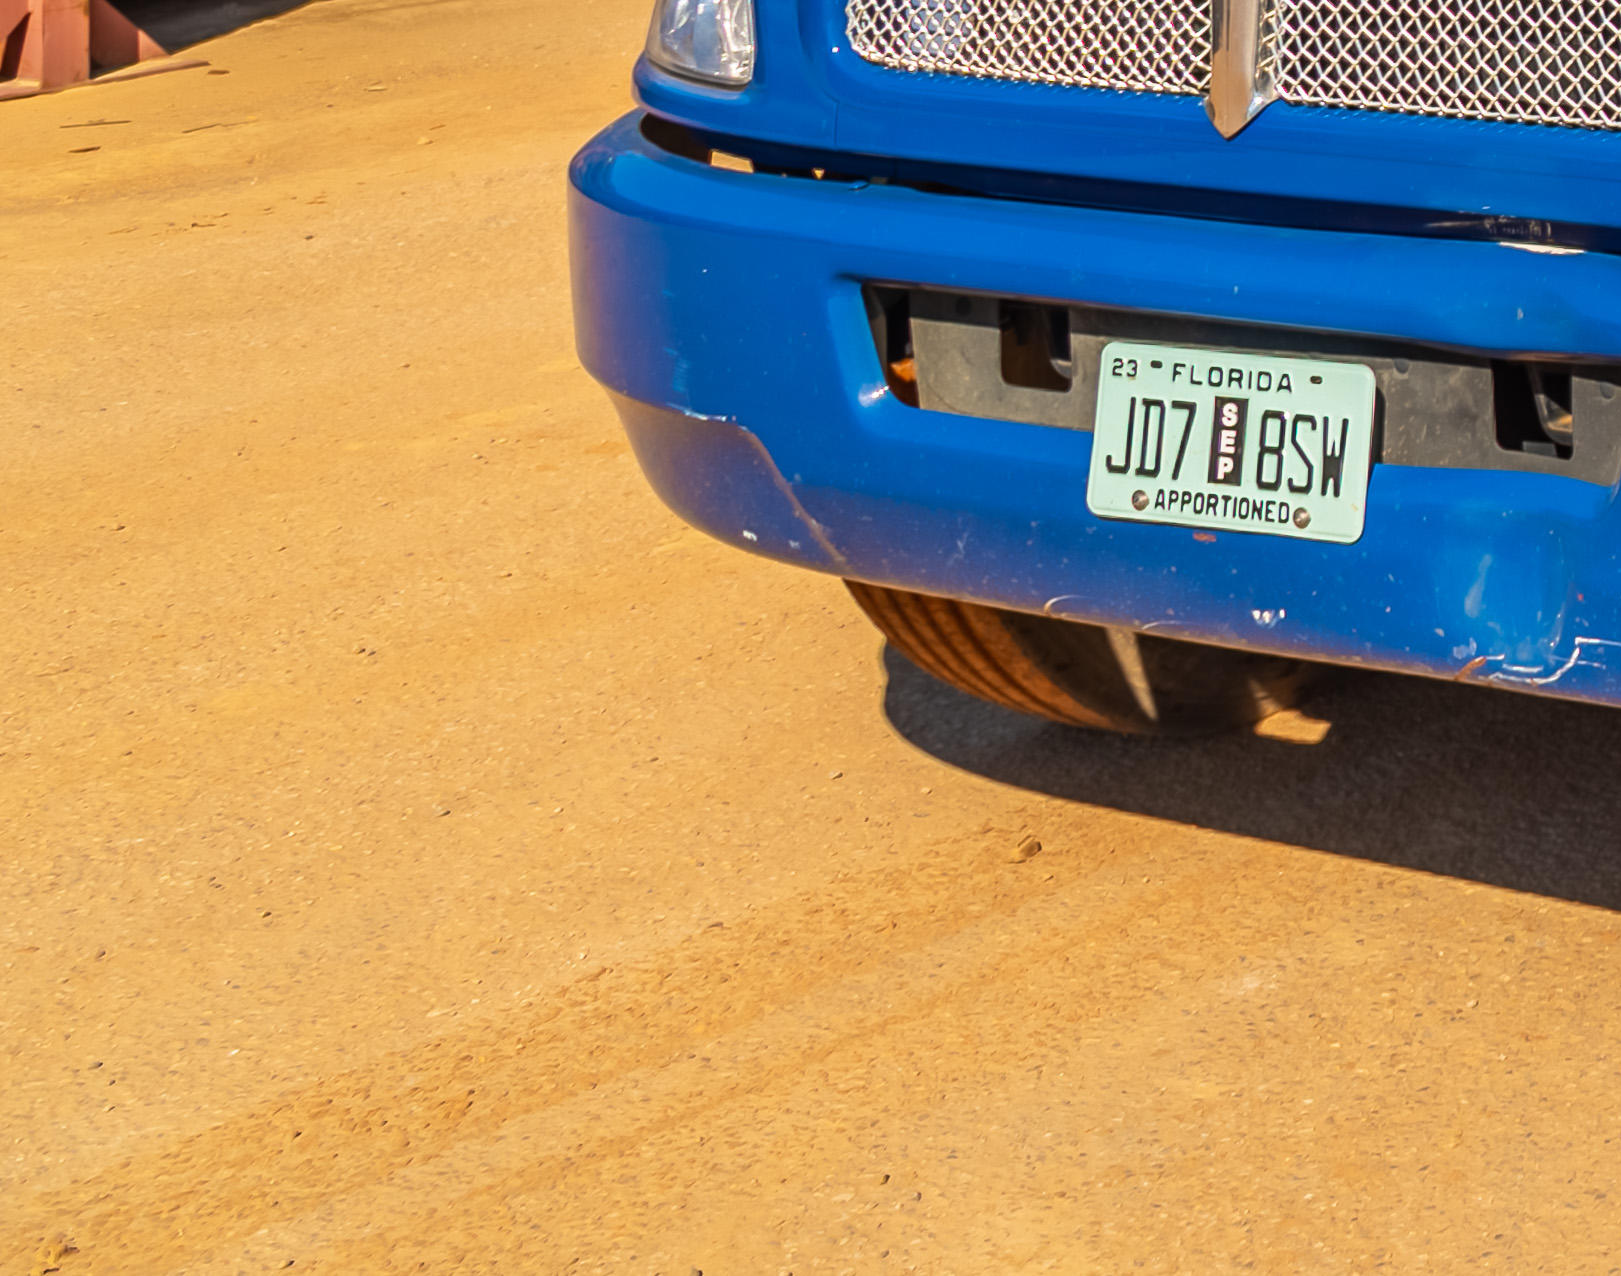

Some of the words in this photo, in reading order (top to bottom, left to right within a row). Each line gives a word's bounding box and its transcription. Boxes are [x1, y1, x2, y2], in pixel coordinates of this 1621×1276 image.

[1112, 358, 1138, 378] 23
[1172, 362, 1292, 393] FLORIDA
[1106, 397, 1197, 480] JD7
[1216, 402, 1239, 480] SEP
[1154, 489, 1290, 524] APPORTIONED
